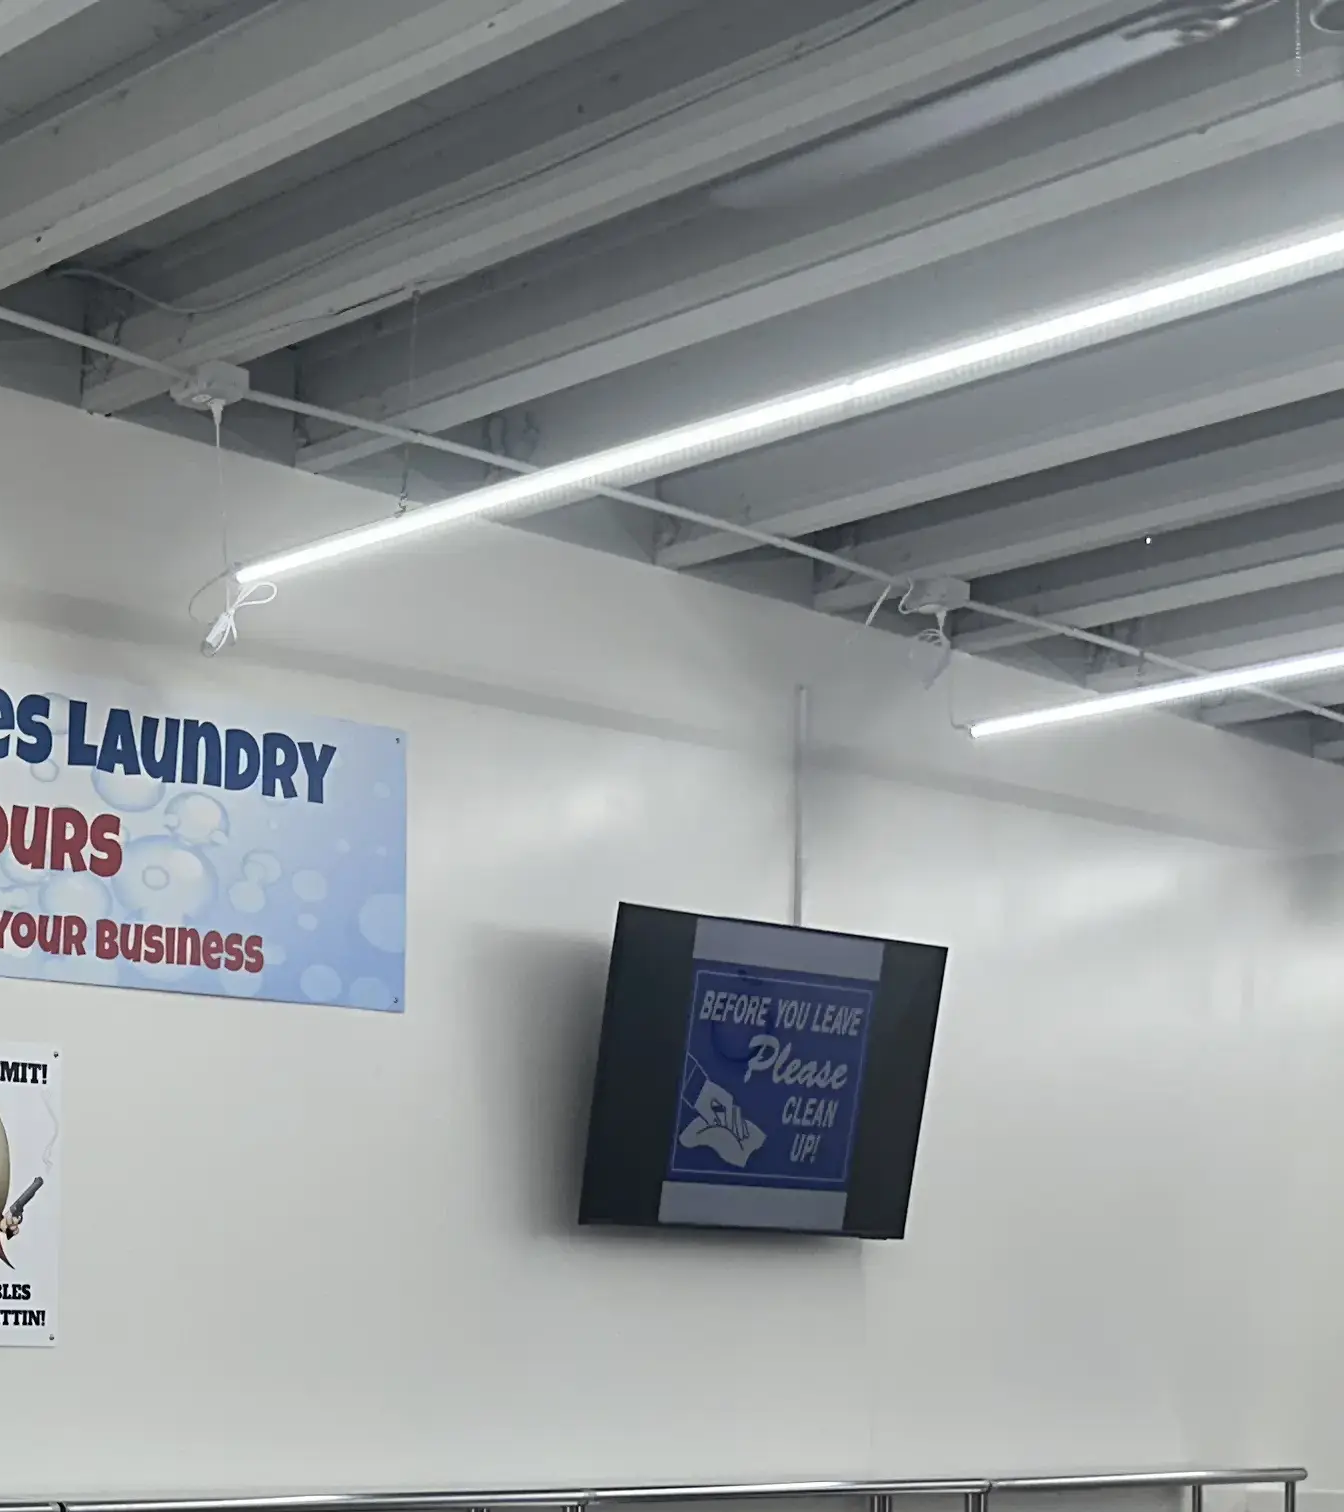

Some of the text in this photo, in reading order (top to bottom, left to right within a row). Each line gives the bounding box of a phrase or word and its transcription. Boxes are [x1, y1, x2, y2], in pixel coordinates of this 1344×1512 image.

[65, 699, 338, 804] LAUNDRY
[93, 917, 266, 974] BUSINESS
[699, 989, 863, 1036] BEFORE YOU LEAVE
[743, 1033, 849, 1091] Please
[781, 1095, 840, 1129] CLEAN
[789, 1132, 821, 1164] UP!
